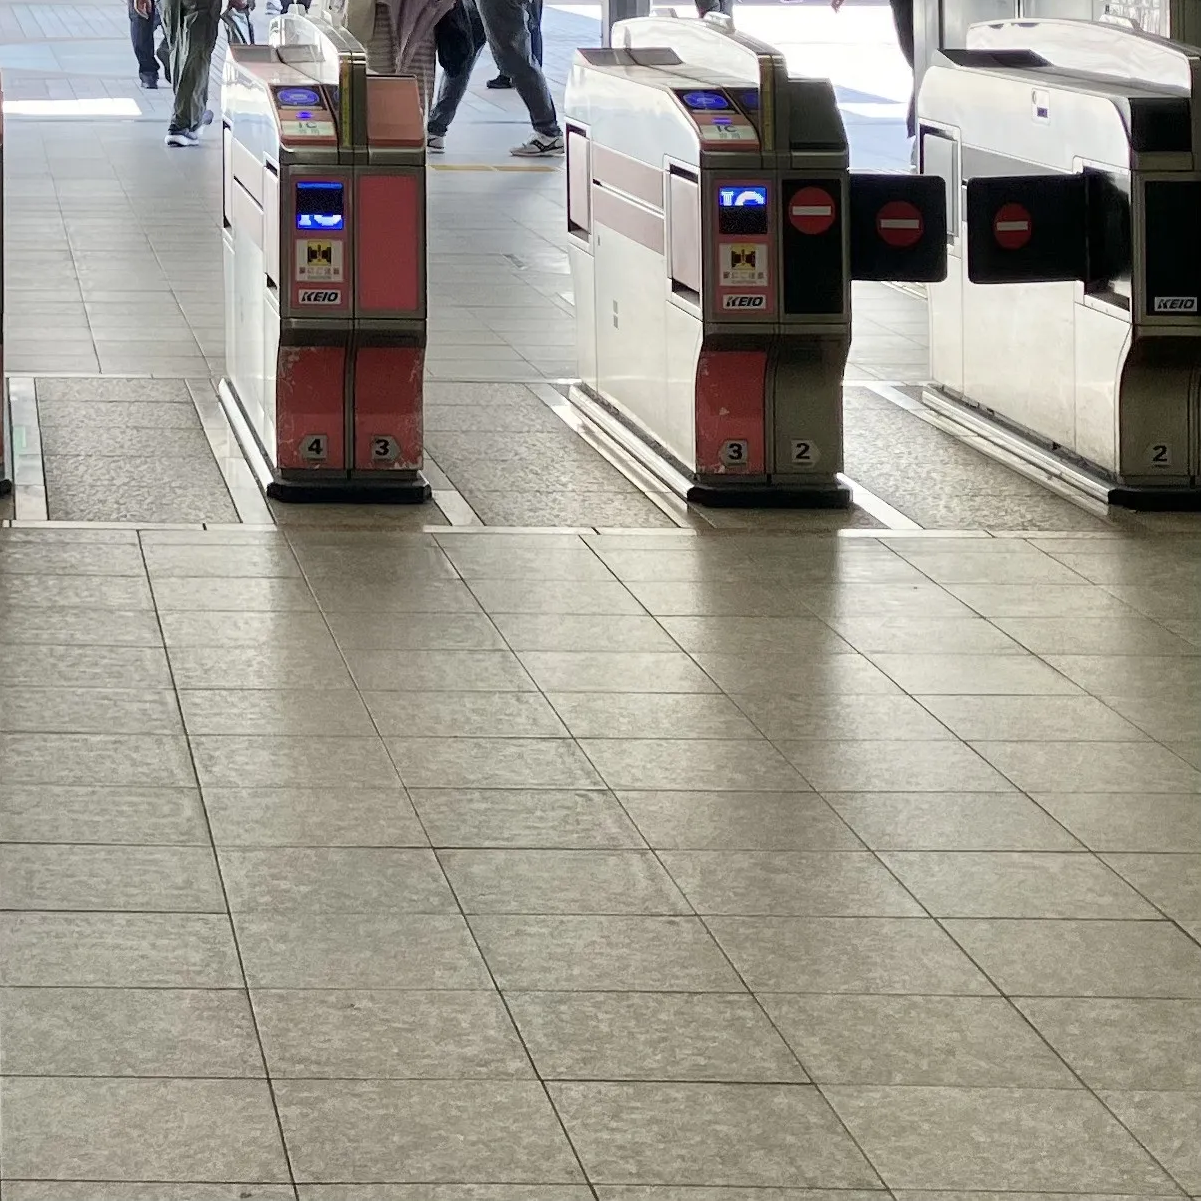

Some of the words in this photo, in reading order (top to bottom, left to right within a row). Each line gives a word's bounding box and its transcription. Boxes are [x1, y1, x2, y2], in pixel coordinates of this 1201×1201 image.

[301, 291, 339, 302] KEIO
[726, 296, 764, 307] KEIO
[1157, 298, 1195, 310] KEIO
[307, 438, 322, 454] 4
[374, 439, 389, 456] 3
[728, 443, 743, 460] 3
[795, 442, 811, 460] 2
[1152, 445, 1168, 462] 2
